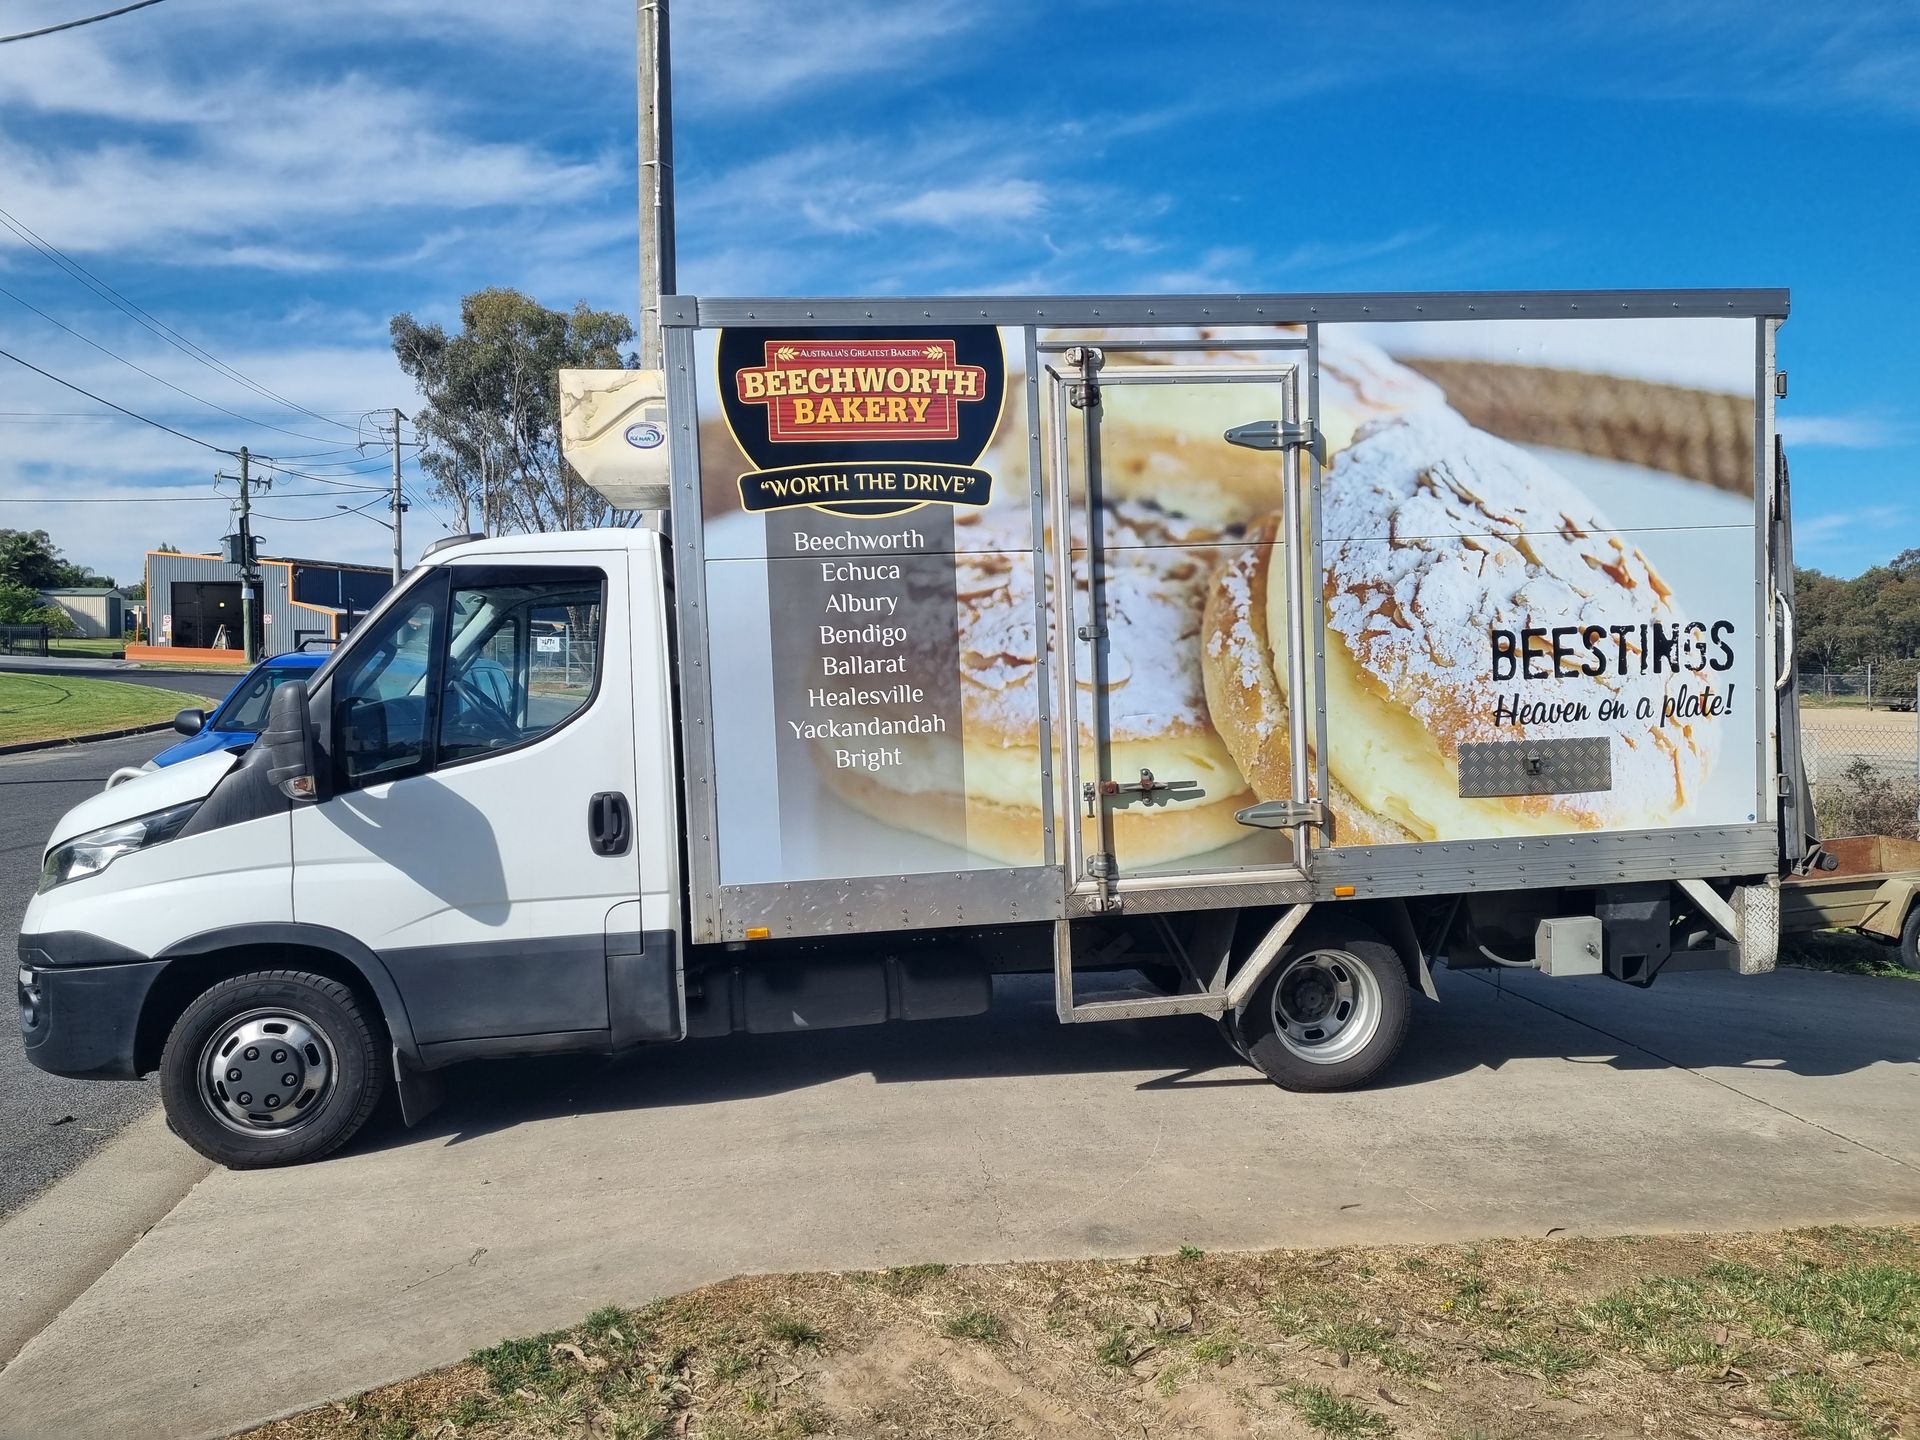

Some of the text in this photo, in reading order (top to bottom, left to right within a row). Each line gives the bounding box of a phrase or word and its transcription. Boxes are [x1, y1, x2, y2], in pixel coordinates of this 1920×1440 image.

[850, 348, 890, 358] GREATEST
[890, 348, 922, 358] BAKERY
[742, 366, 978, 398] BEECHWORTH
[793, 397, 931, 425] BAKERY
[854, 472, 897, 492] THE
[792, 529, 925, 551] Beechworth
[820, 562, 900, 582] Echuca
[825, 593, 898, 615] Albury
[819, 624, 907, 647] Bendigo
[1491, 620, 1735, 681] BEESTINGS
[821, 654, 907, 676] Ballarat
[808, 684, 924, 707] Healesville
[1492, 683, 1736, 728] Heaven on a plate!
[788, 714, 946, 739] Yackandandah
[834, 748, 903, 771] Bright
